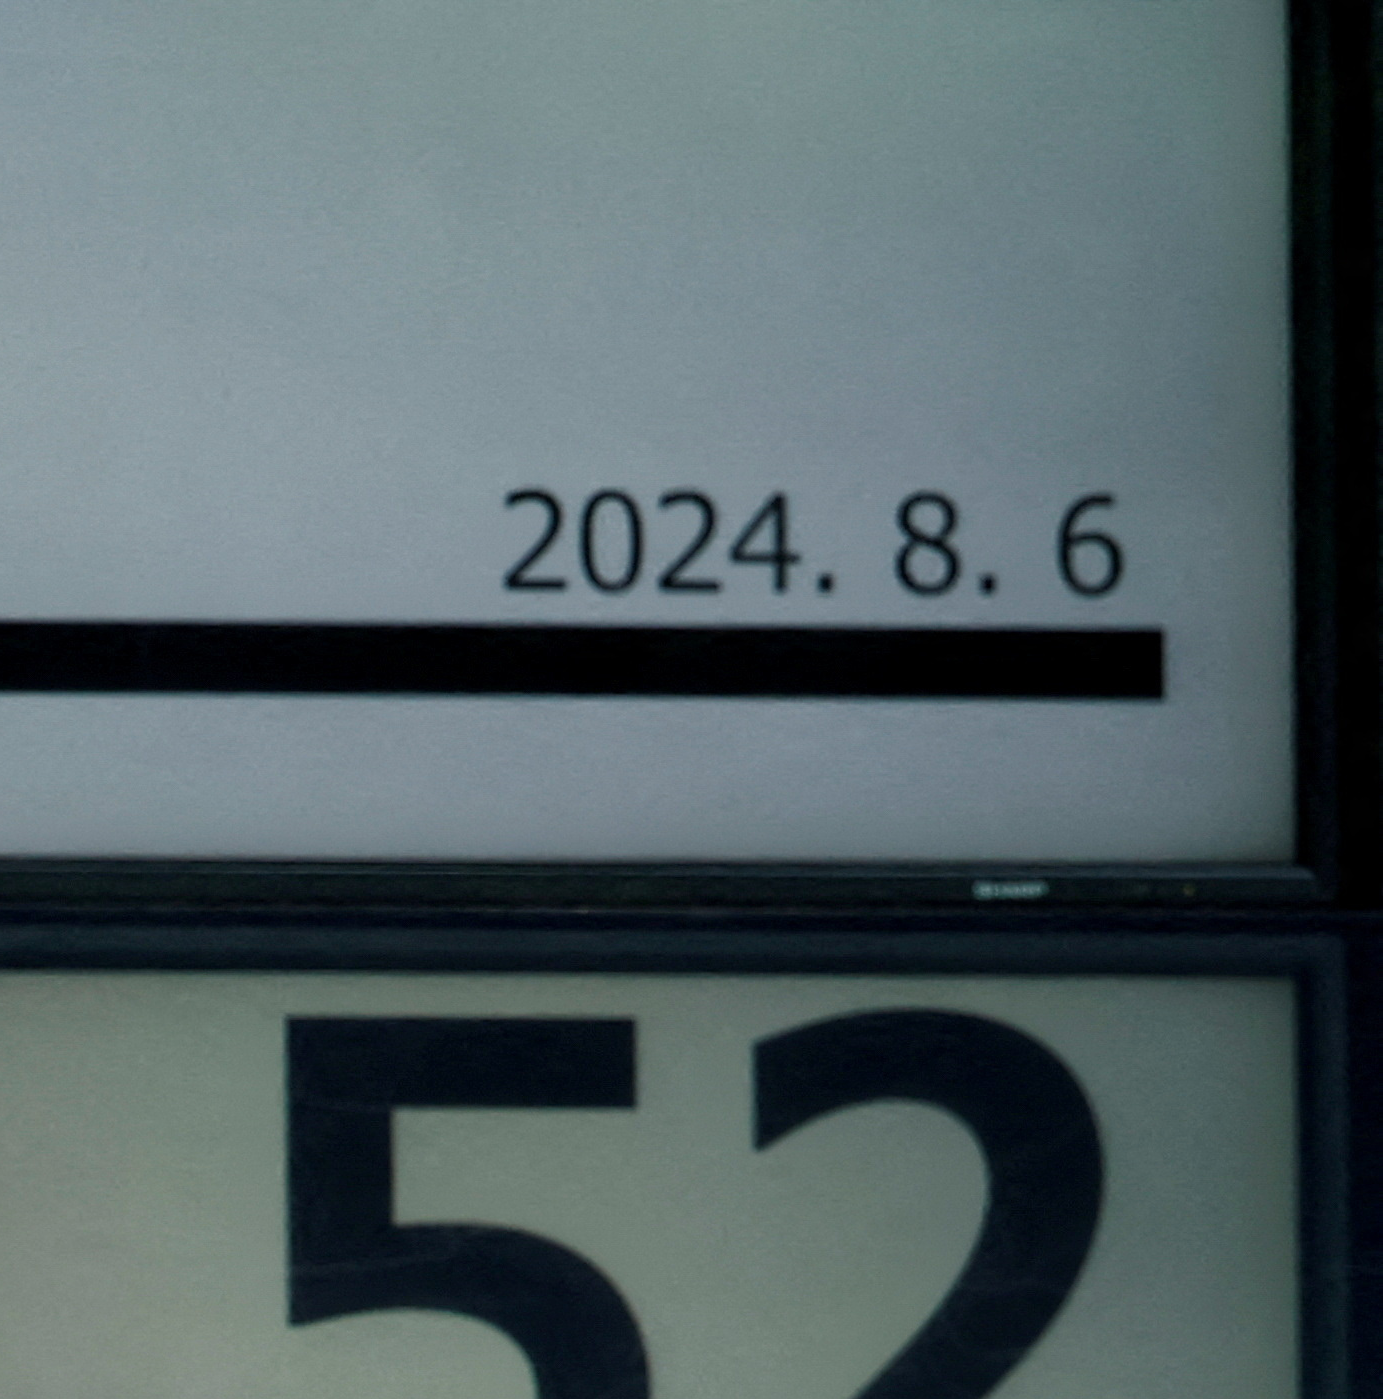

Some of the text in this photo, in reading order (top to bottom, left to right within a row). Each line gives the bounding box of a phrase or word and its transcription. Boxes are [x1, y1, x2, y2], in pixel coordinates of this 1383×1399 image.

[502, 487, 1126, 599] 2024. 8. 6
